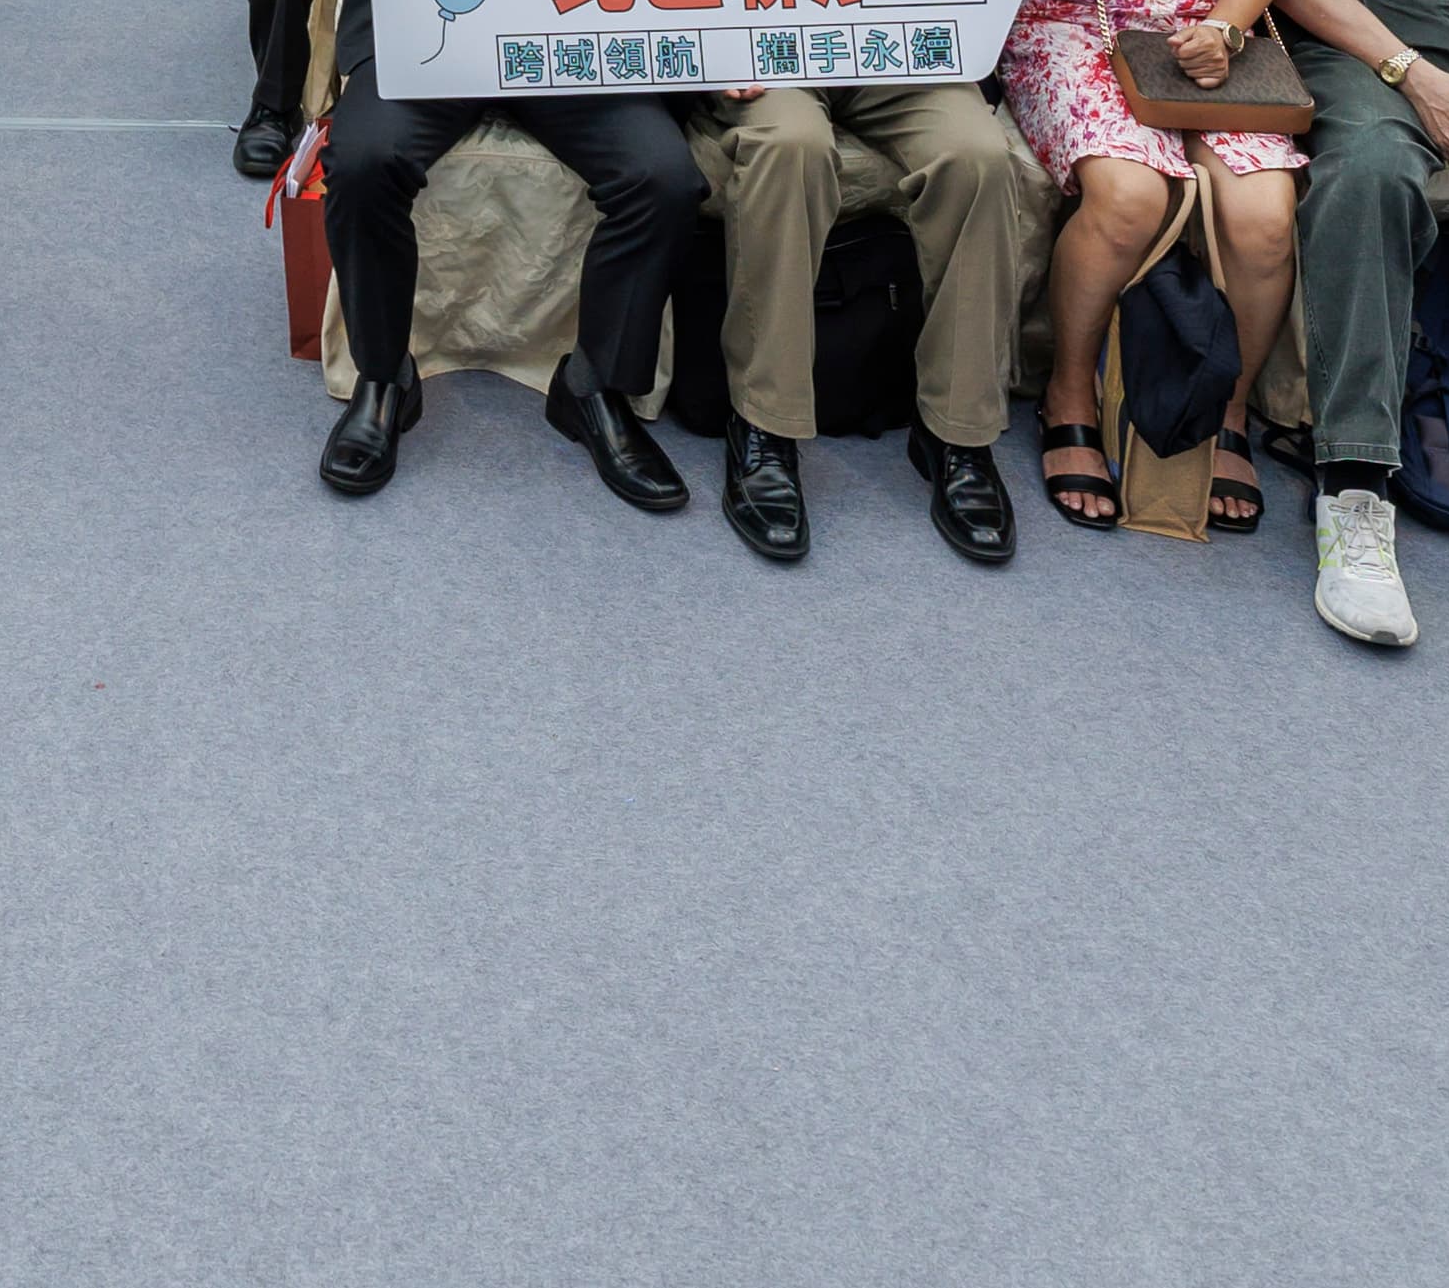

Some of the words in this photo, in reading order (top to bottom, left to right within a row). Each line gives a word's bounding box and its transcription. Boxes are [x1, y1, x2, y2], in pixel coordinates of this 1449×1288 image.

[502, 38, 701, 82] 跨域領航
[756, 25, 956, 76] 攜手永續
